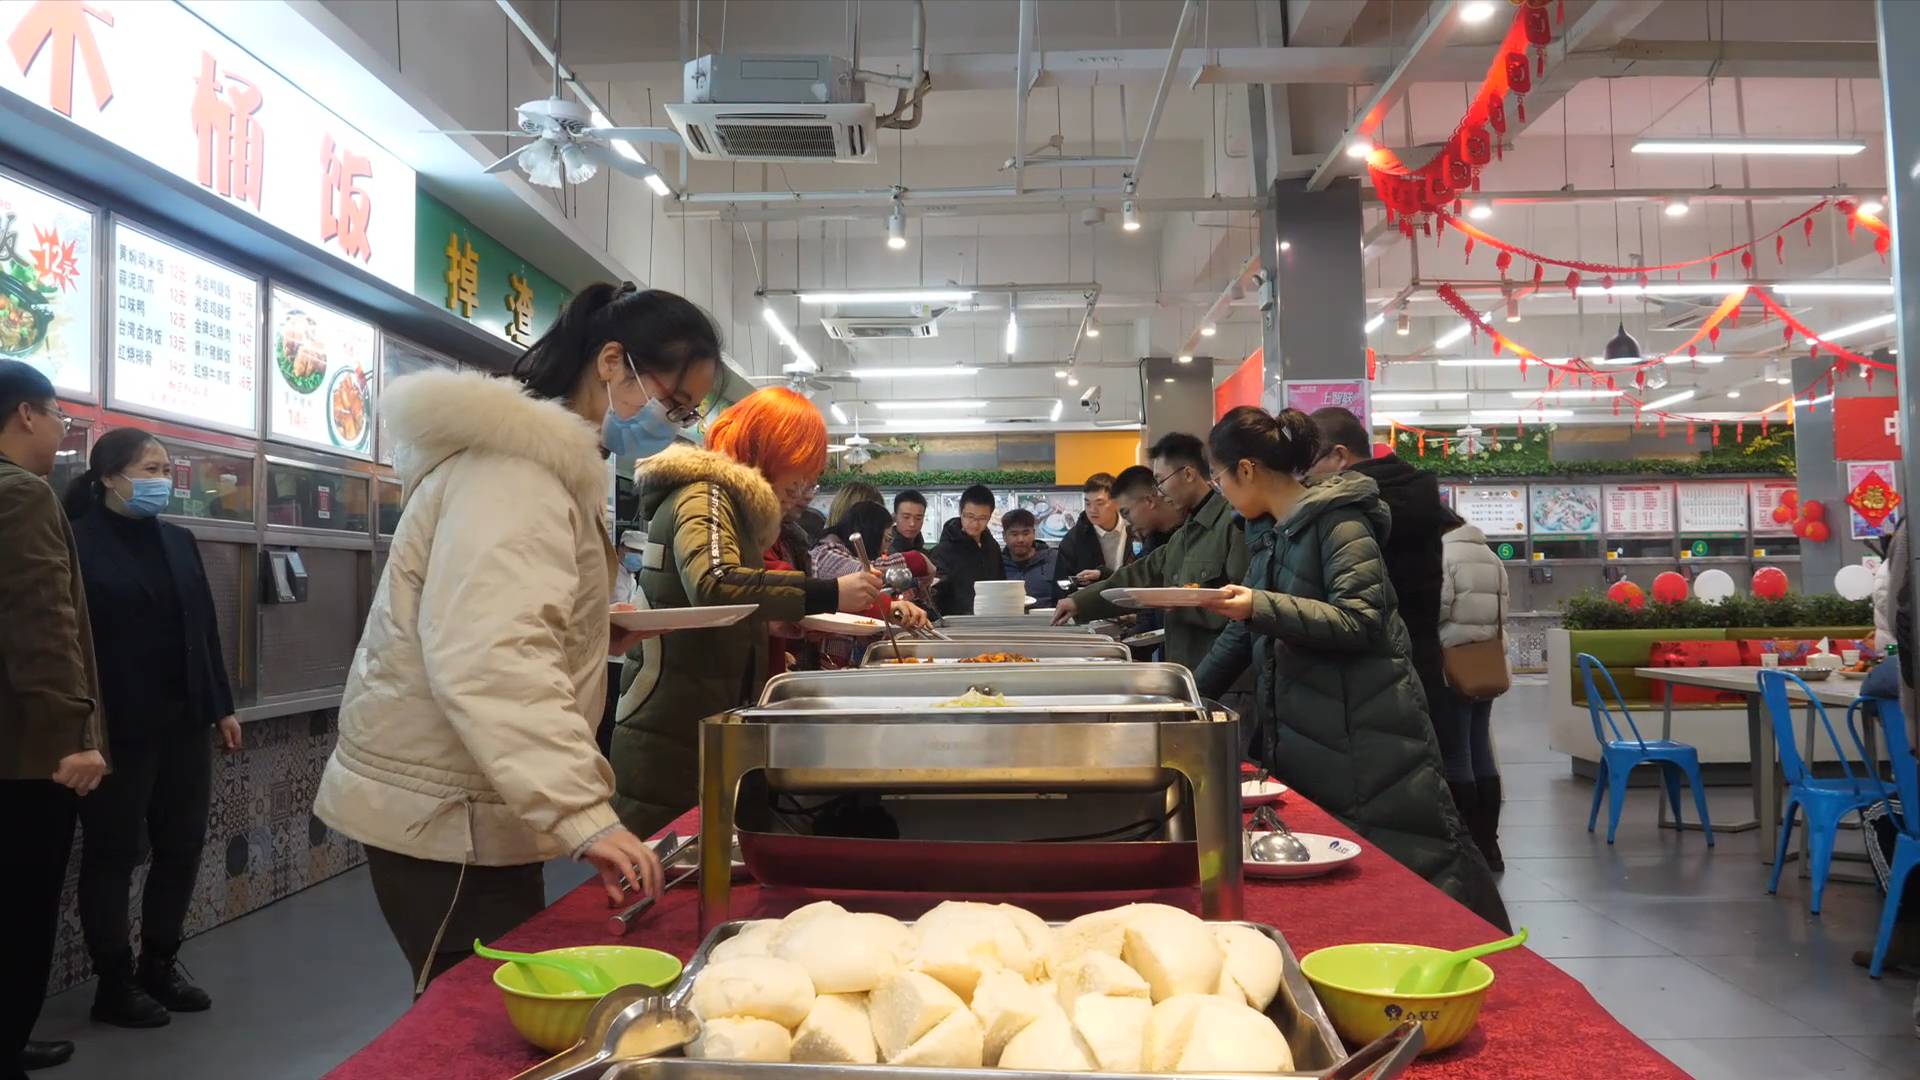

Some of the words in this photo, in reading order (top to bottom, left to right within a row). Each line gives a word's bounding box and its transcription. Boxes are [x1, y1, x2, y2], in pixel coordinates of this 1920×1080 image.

[444, 231, 570, 349] 掉渣
[118, 318, 163, 346] 台湾卤肉饭
[169, 335, 187, 353] 13元
[169, 311, 187, 330] 12元
